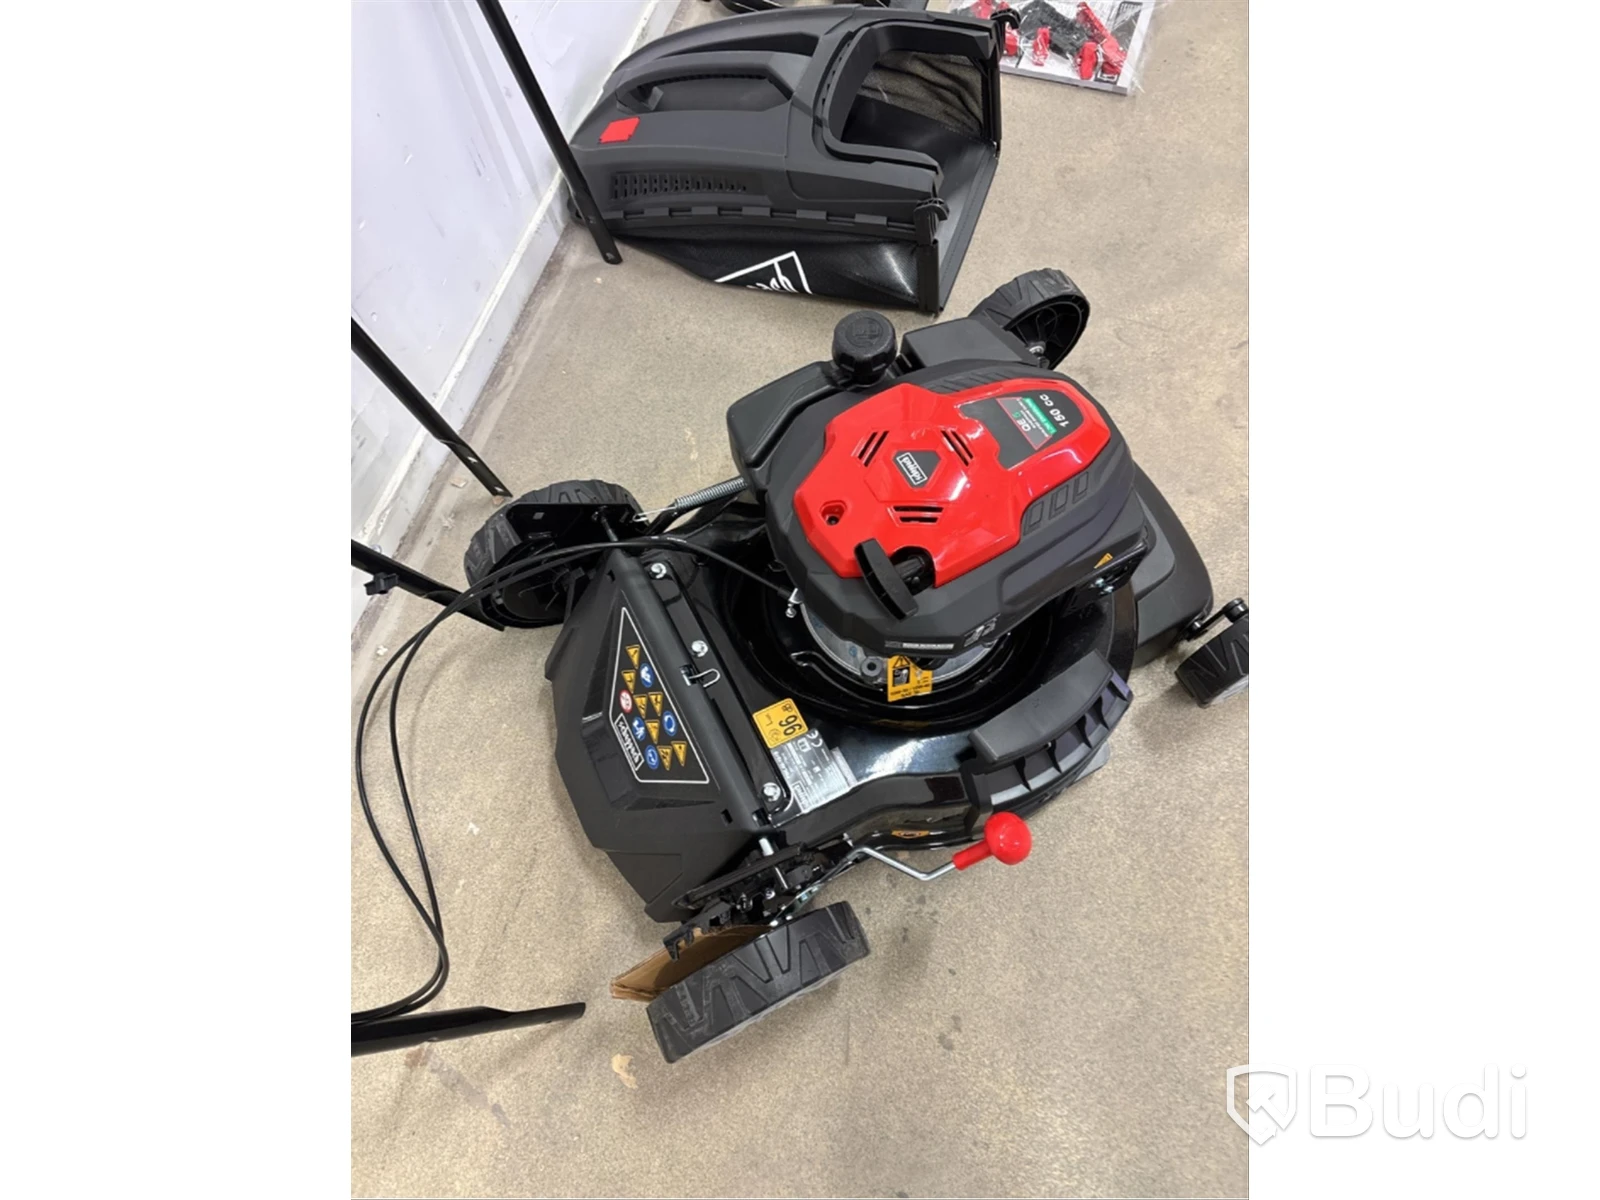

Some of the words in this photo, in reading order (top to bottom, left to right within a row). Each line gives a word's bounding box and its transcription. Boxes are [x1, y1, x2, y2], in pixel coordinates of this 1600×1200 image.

[1039, 393, 1054, 407] cc
[1049, 408, 1069, 427] 150
[778, 714, 803, 736] 96
